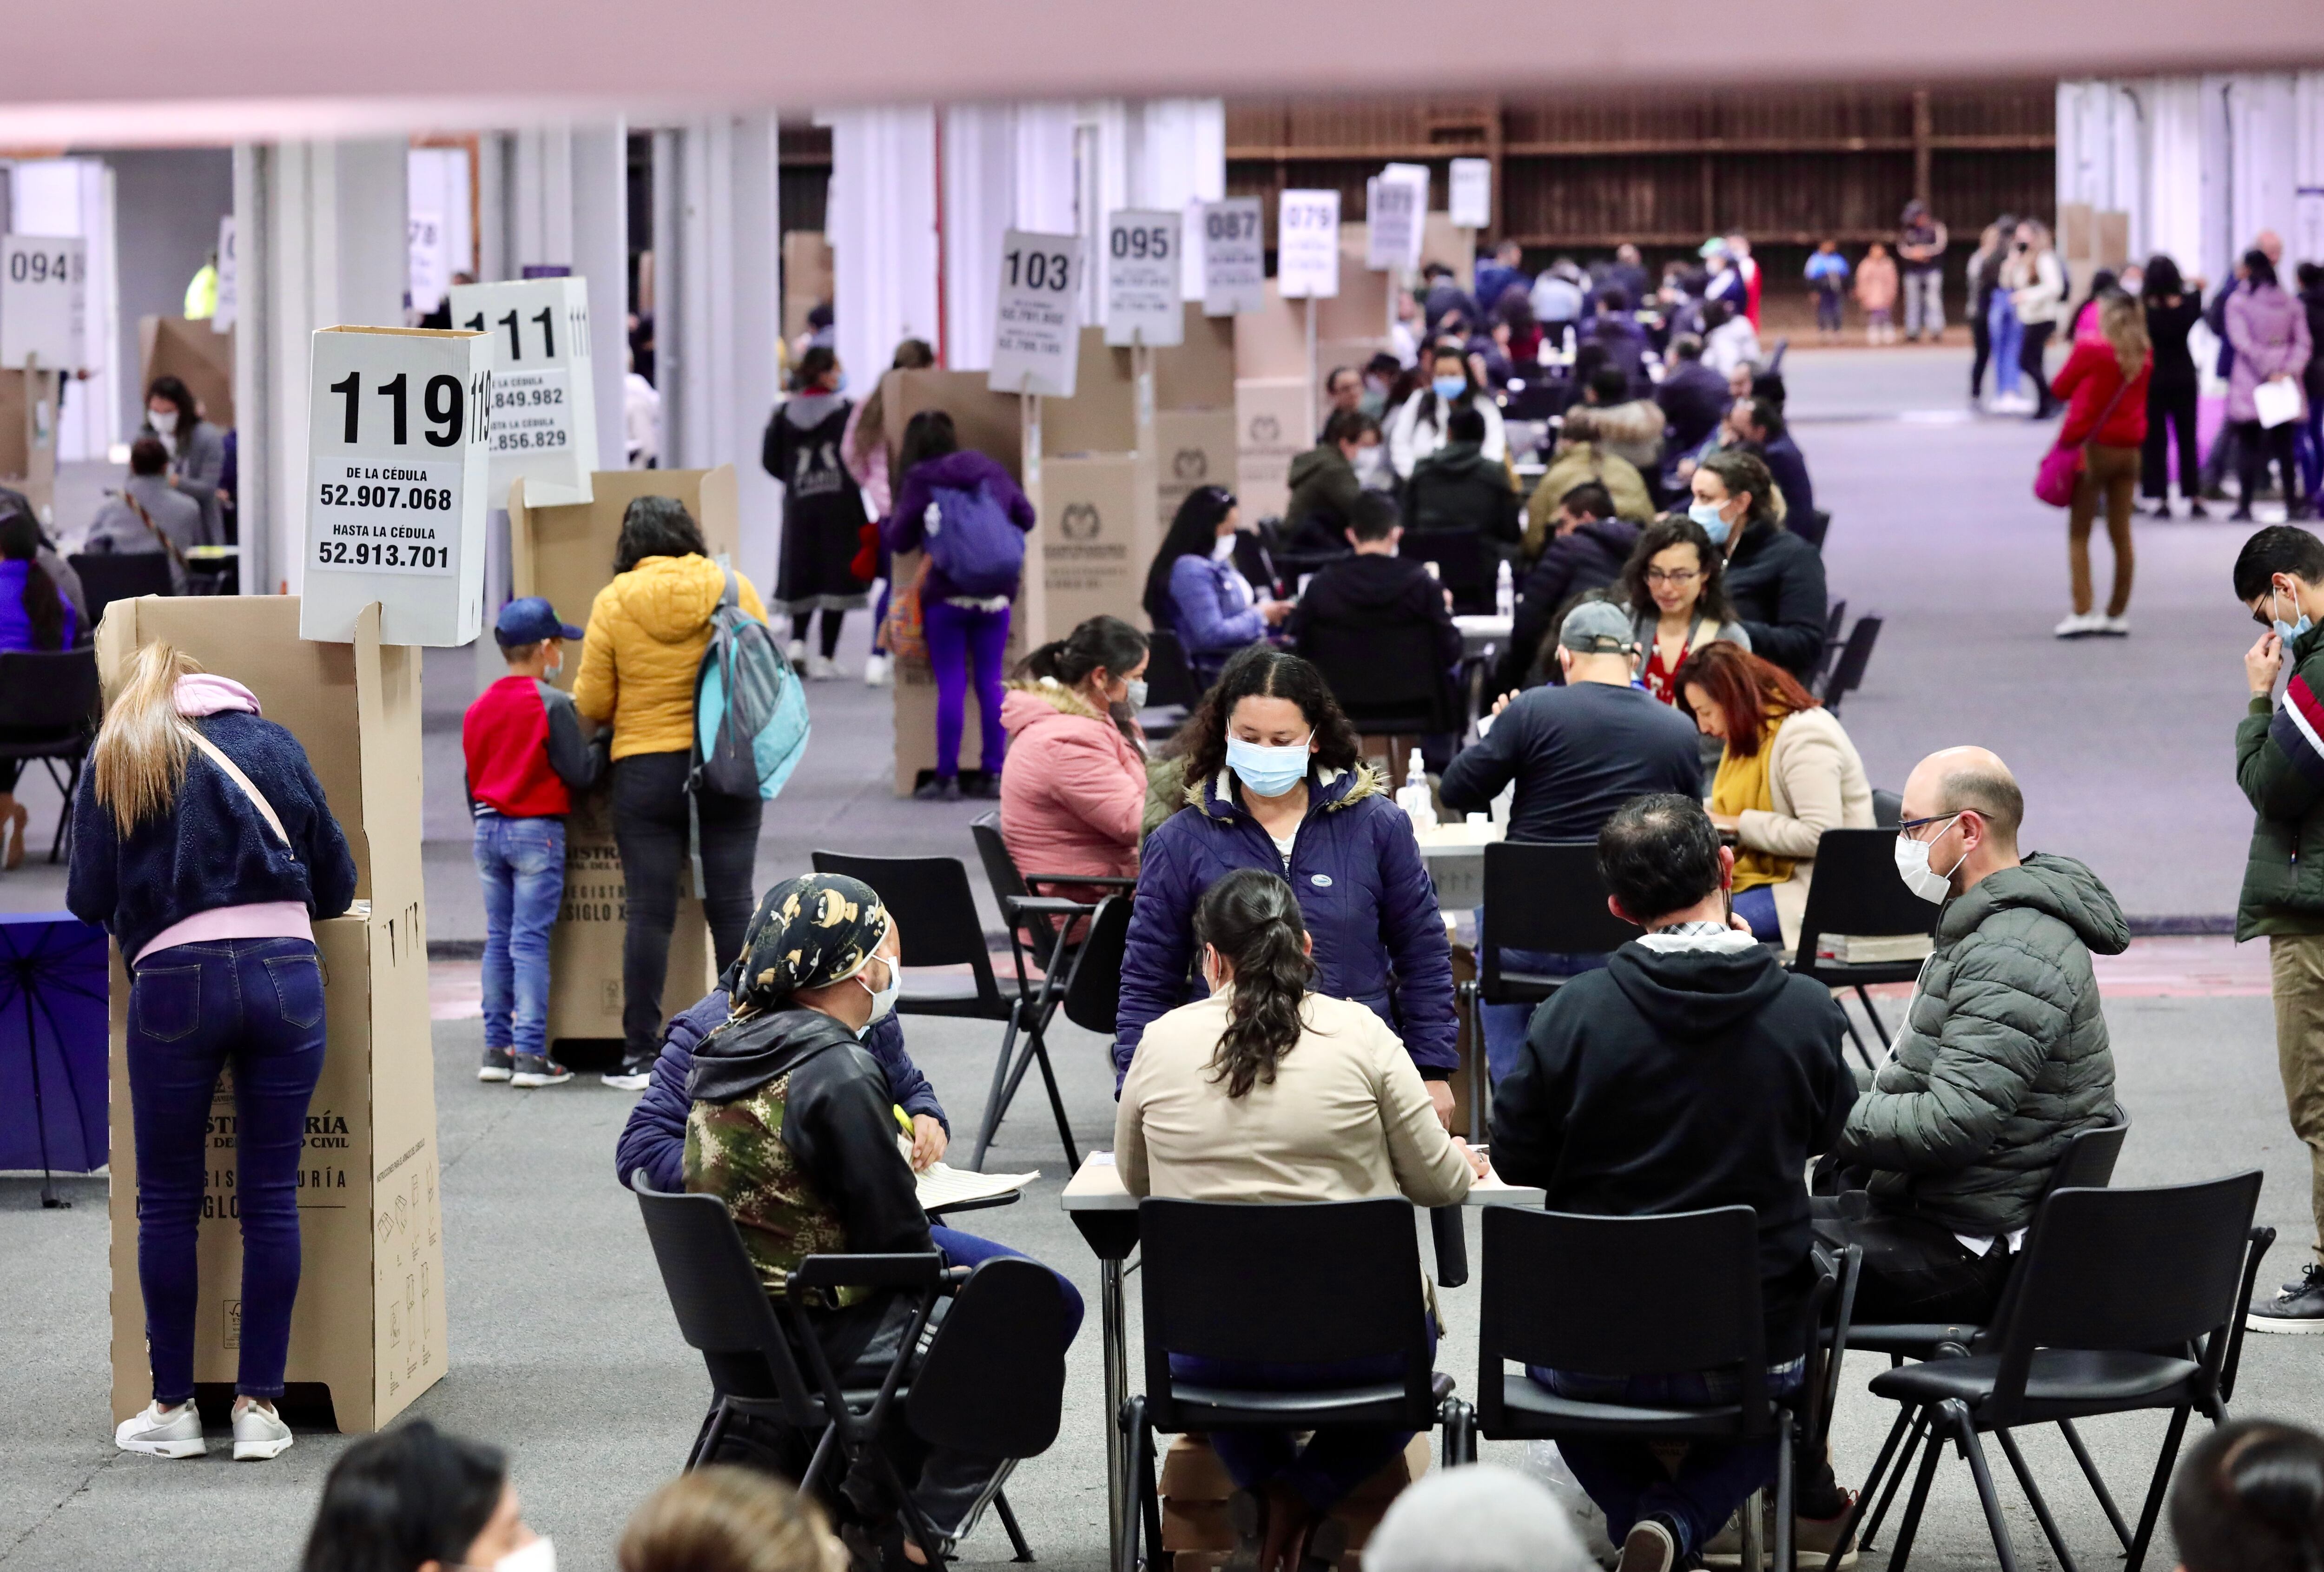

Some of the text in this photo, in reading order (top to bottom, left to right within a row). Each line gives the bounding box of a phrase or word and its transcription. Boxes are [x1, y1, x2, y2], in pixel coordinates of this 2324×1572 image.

[1207, 211, 1256, 240] 087
[1111, 227, 1168, 259] 095
[11, 251, 66, 282] 094
[1005, 248, 1068, 291] 103
[498, 379, 508, 388] LA
[331, 372, 464, 447] 119
[471, 370, 491, 443] 119
[491, 387, 563, 409] .849.982
[489, 429, 566, 452] .856.829
[346, 467, 427, 482] DE LA CÉDULA
[320, 484, 451, 510] 52.907.068
[333, 524, 435, 539] HASTA LA CÉDULA
[319, 542, 448, 568] 52.913.701
[310, 1137, 349, 1148] CIVIL
[203, 1195, 238, 1218] GLO
